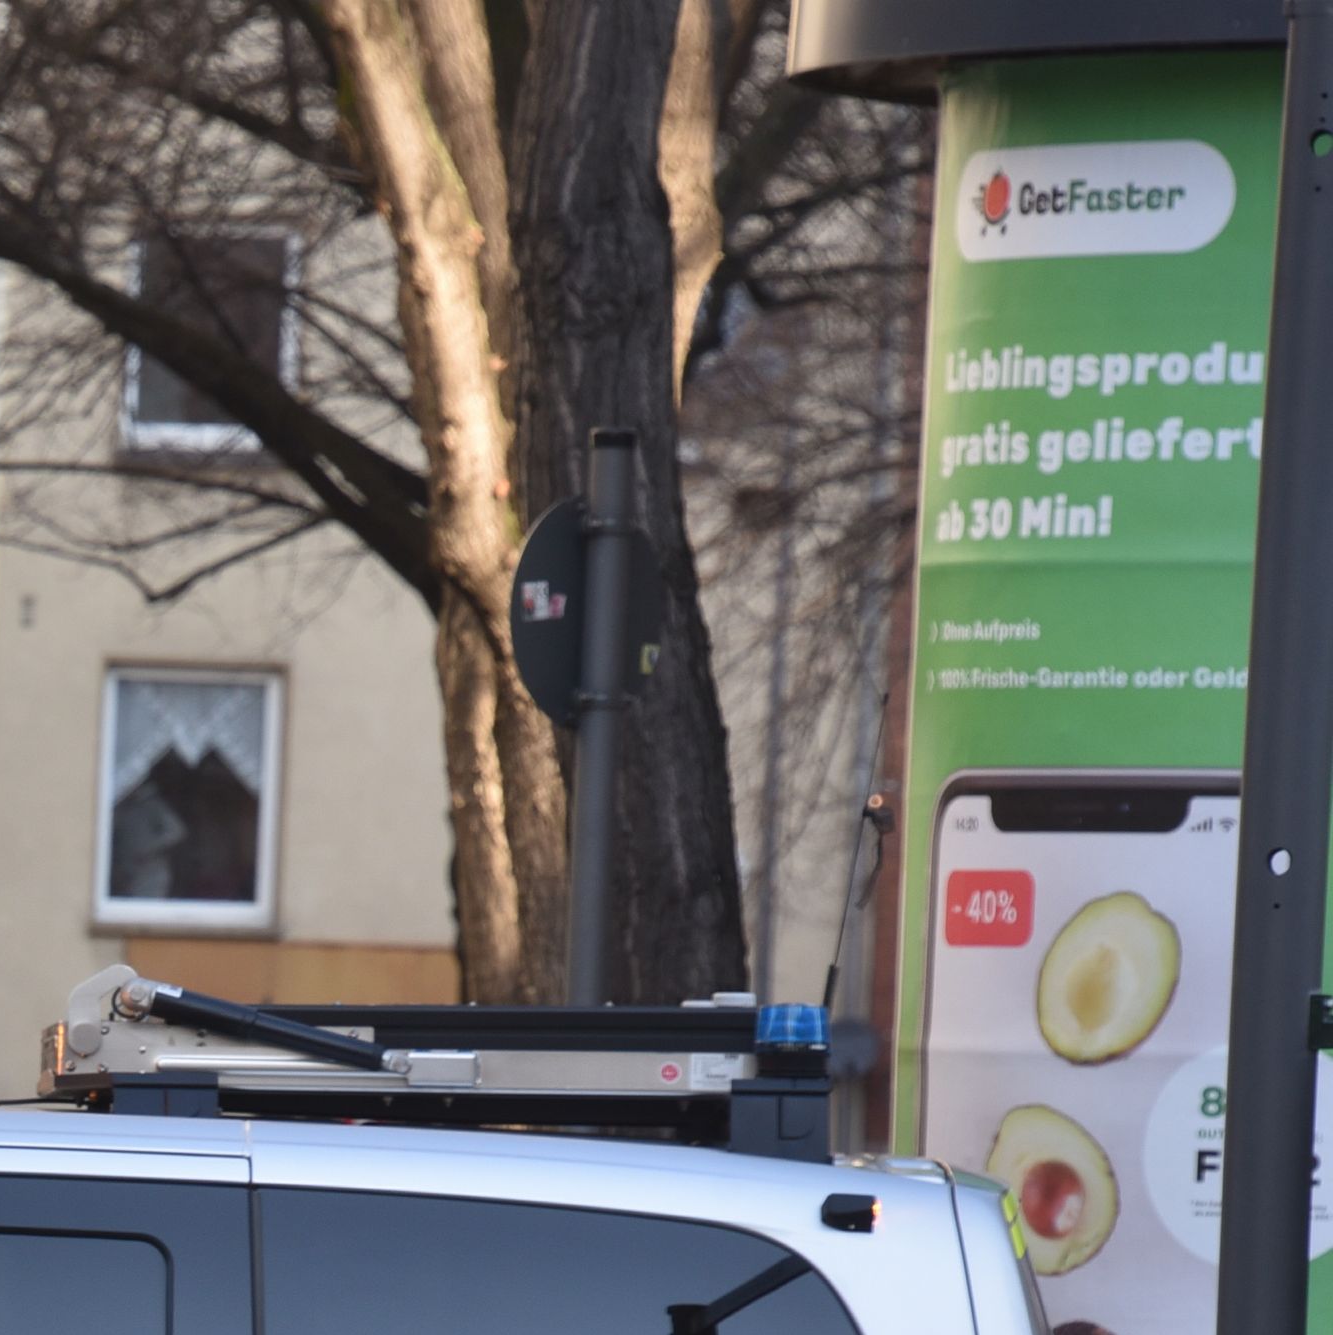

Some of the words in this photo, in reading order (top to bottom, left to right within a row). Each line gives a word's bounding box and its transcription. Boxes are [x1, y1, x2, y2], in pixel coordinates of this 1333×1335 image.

[1019, 178, 1186, 216] GetFaster
[944, 341, 1264, 399] Lieblingsprodu
[940, 420, 1030, 478] gratis
[1037, 416, 1262, 475] geliefert
[936, 500, 965, 542] ab
[969, 497, 1013, 540] 30
[1018, 493, 1113, 539] Min!
[973, 617, 1041, 645] Aufpreis
[1133, 667, 1189, 690] oder
